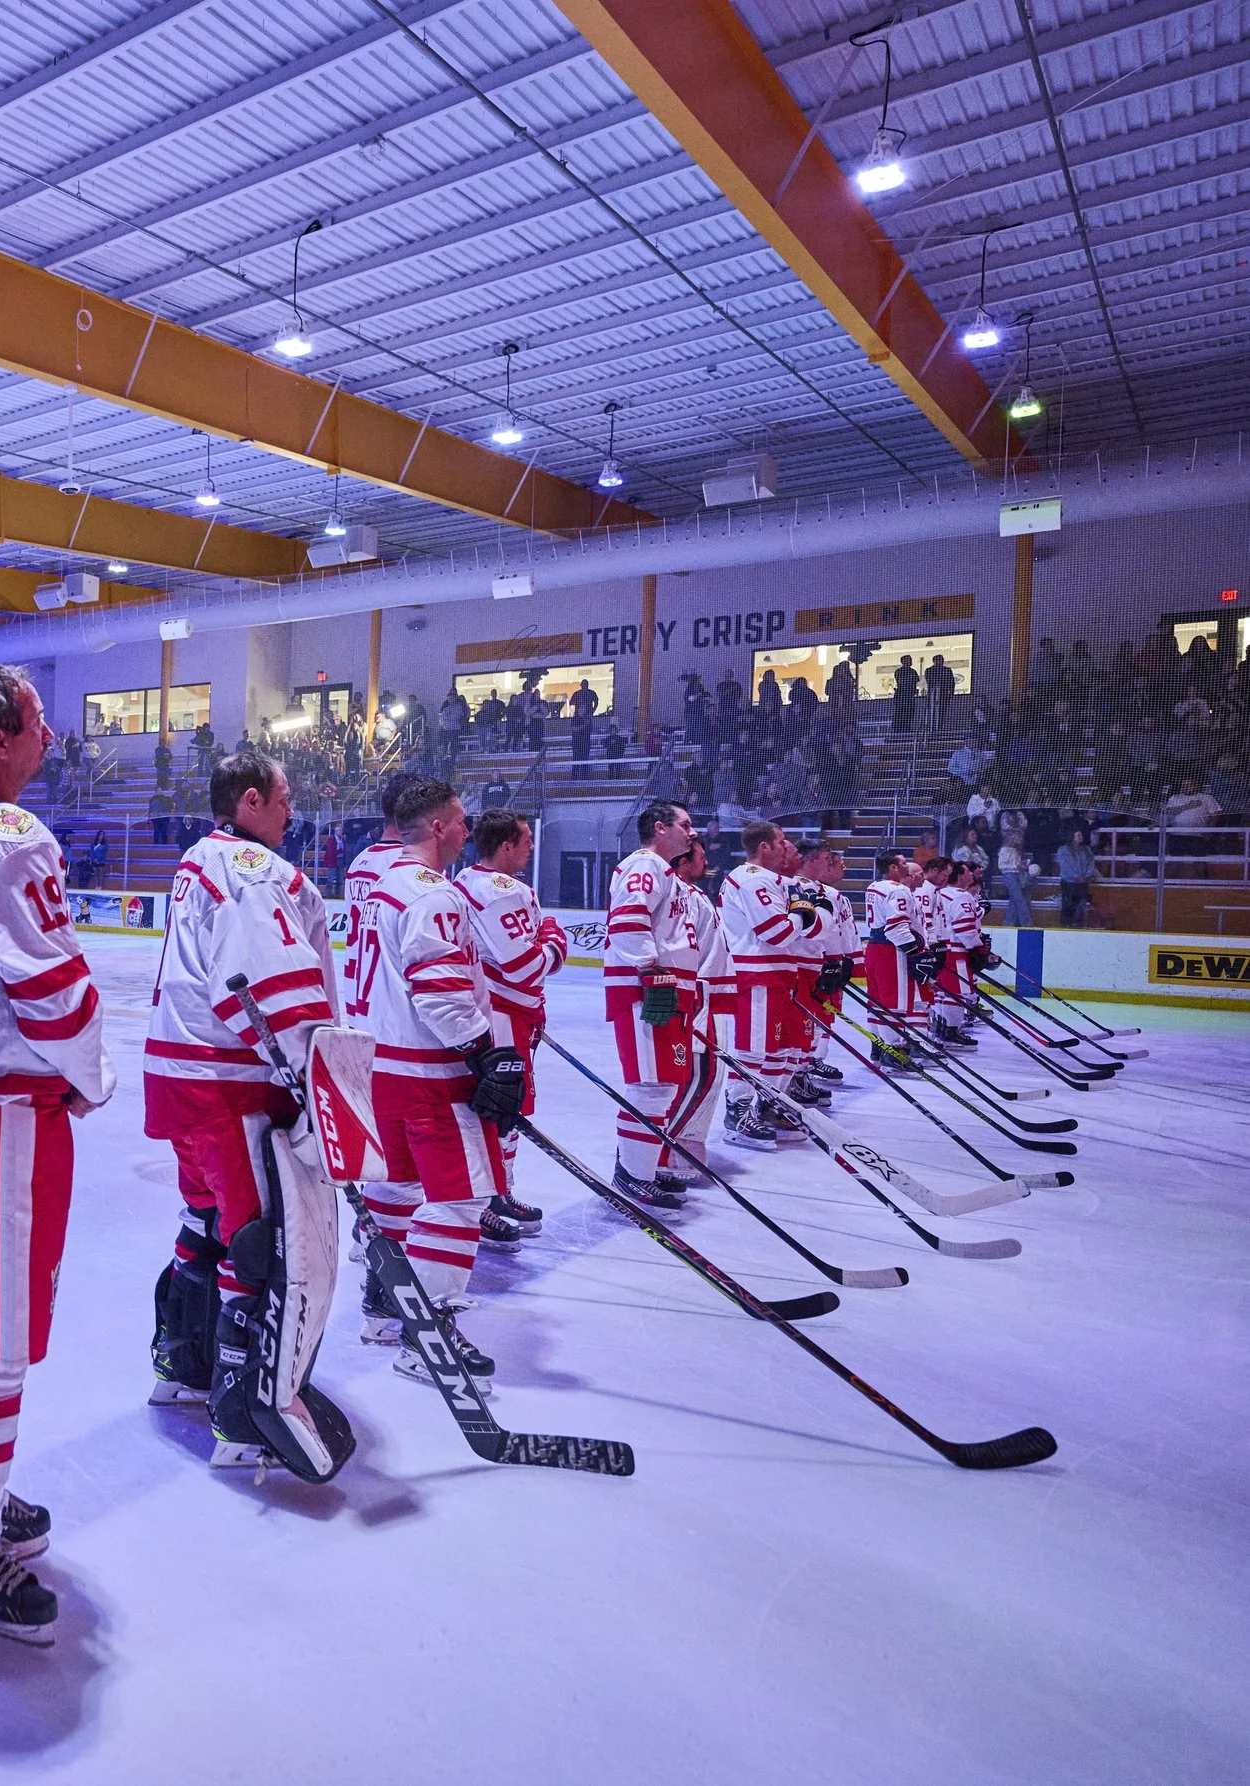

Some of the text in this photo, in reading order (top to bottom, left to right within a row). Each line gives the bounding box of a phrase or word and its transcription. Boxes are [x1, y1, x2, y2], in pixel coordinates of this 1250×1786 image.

[1221, 590, 1238, 600] EXIT
[587, 620, 677, 657] TERY
[693, 611, 785, 649] CRISP
[626, 872, 654, 895] 28
[755, 887, 772, 906] 6
[24, 875, 70, 934] 19
[897, 898, 907, 911] 2
[273, 907, 297, 946] 1
[433, 912, 461, 946] 17
[500, 908, 534, 940] 92
[316, 1085, 346, 1171] CCM
[222, 1351, 246, 1362] CCM
[257, 1289, 281, 1407] CCM
[393, 1280, 481, 1411] CCM
